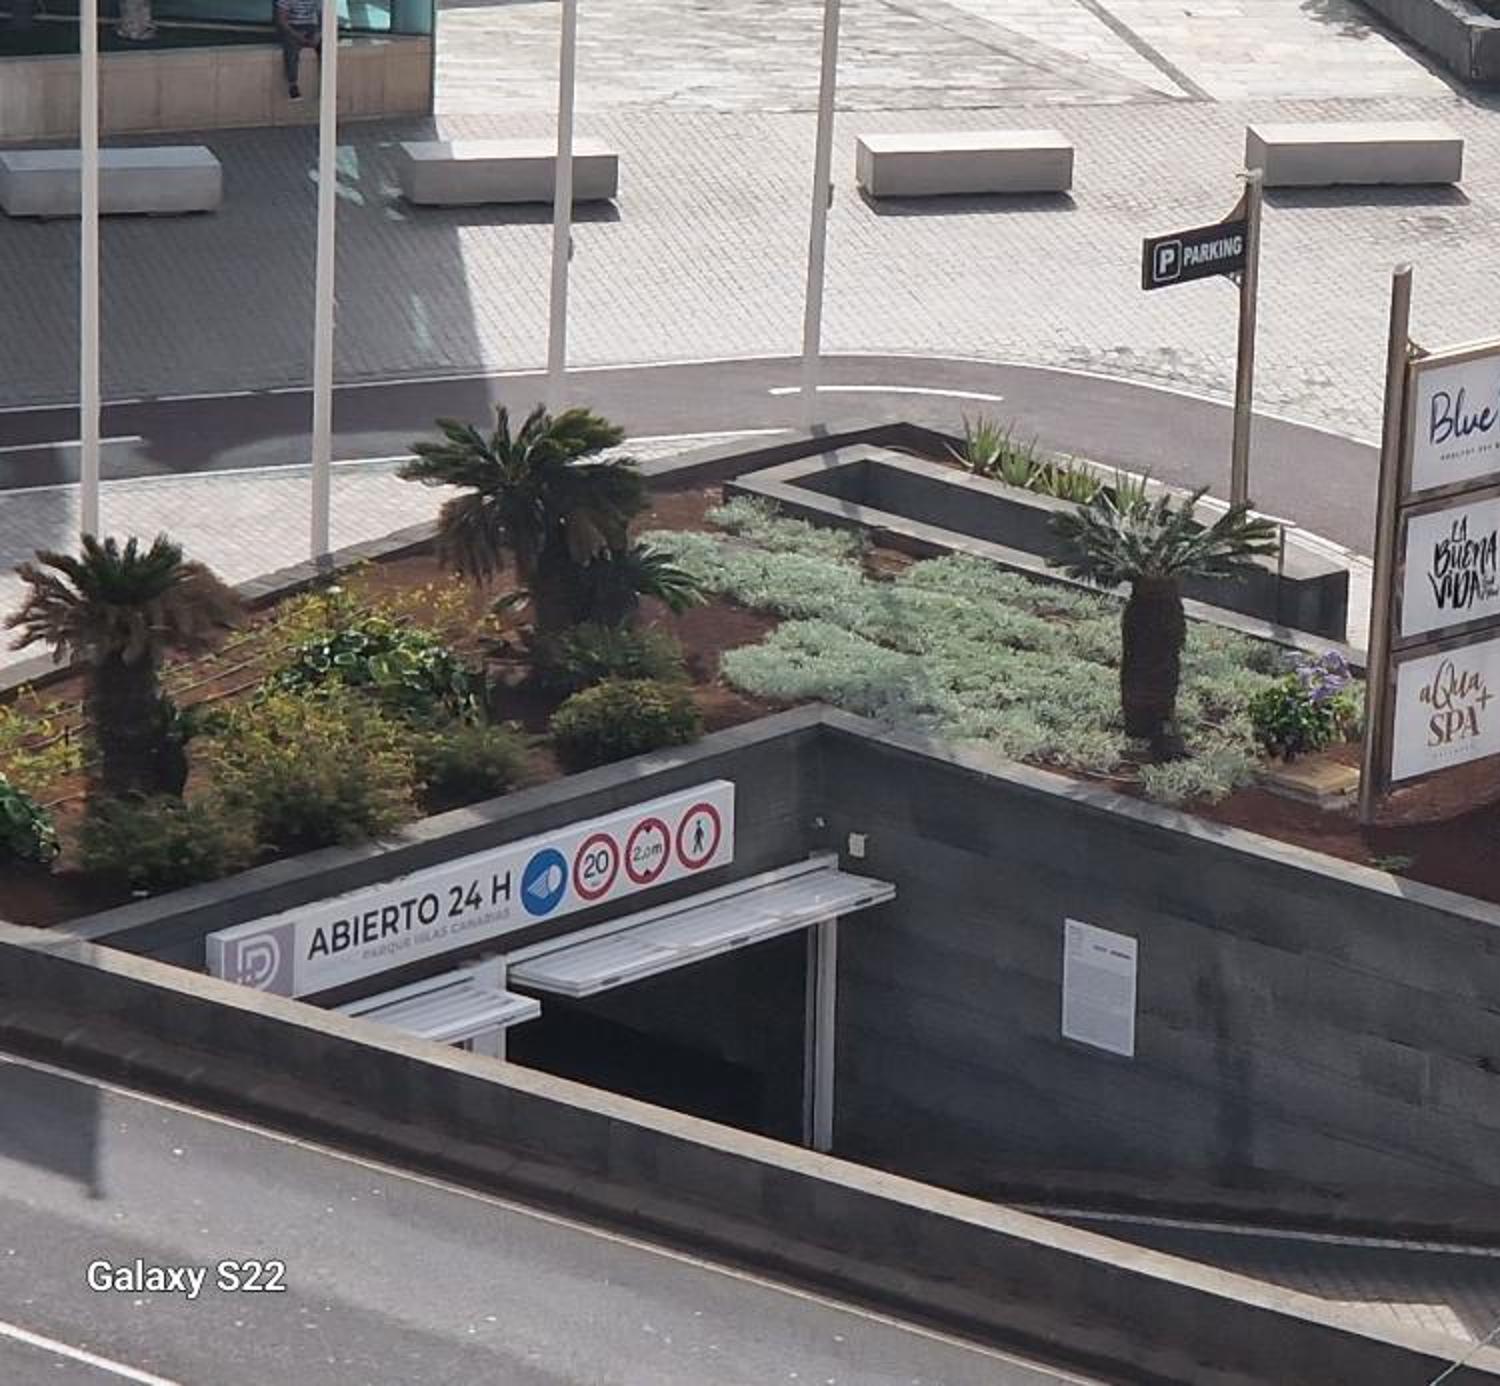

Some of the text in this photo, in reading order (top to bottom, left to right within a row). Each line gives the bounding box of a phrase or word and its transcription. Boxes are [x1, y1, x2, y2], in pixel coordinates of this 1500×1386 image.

[1159, 236, 1243, 275] P PARKING
[1451, 515, 1467, 543] LA
[1433, 530, 1497, 579] BUENA
[1427, 706, 1481, 747] SPA
[583, 850, 609, 879] 20
[307, 869, 511, 960] ABIERTO 24 H
